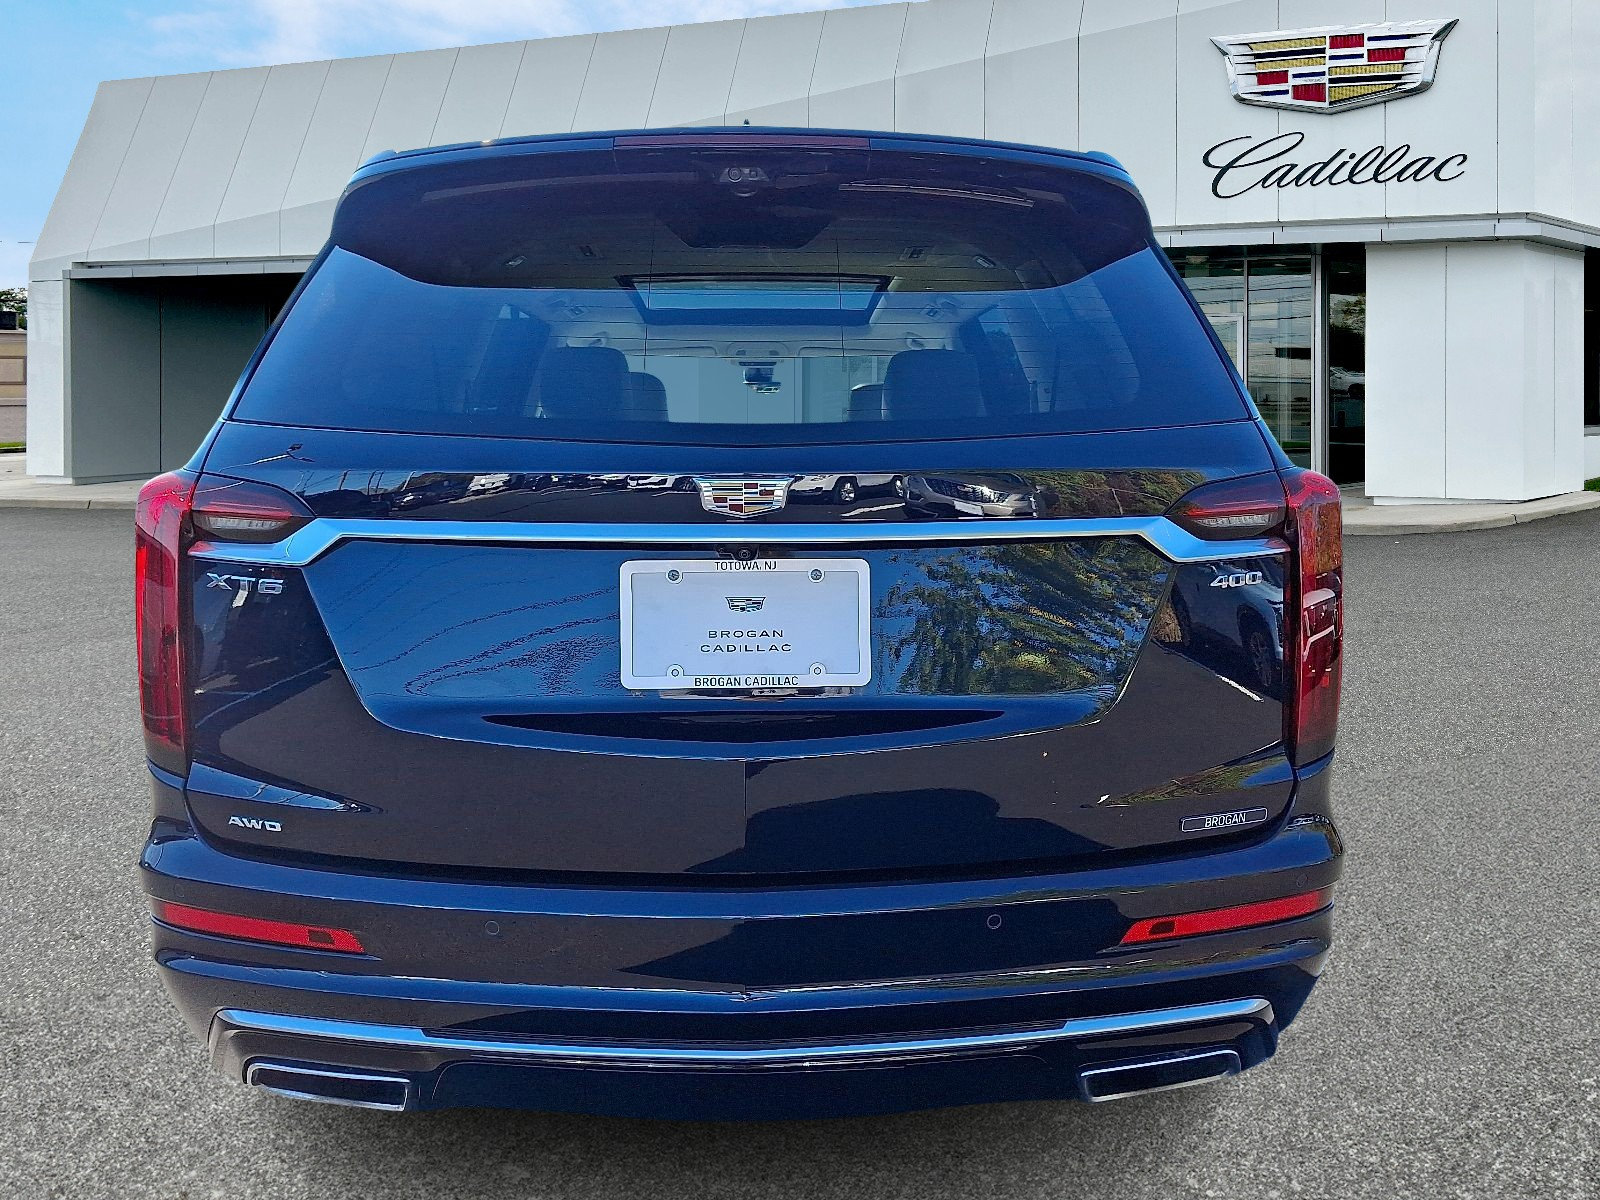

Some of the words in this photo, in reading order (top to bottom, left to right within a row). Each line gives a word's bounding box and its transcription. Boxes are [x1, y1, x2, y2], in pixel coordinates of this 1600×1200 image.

[1202, 131, 1468, 199] Cadillac
[764, 560, 777, 571] NJ
[206, 572, 284, 594] XT6
[1210, 571, 1263, 589] 400
[708, 630, 784, 639] BROGAN
[700, 643, 792, 653] CADILLAC
[694, 676, 741, 687] BROGAN
[744, 675, 799, 687] CADILLAC
[228, 816, 282, 832] AWD
[1204, 813, 1246, 828] BROGAN
